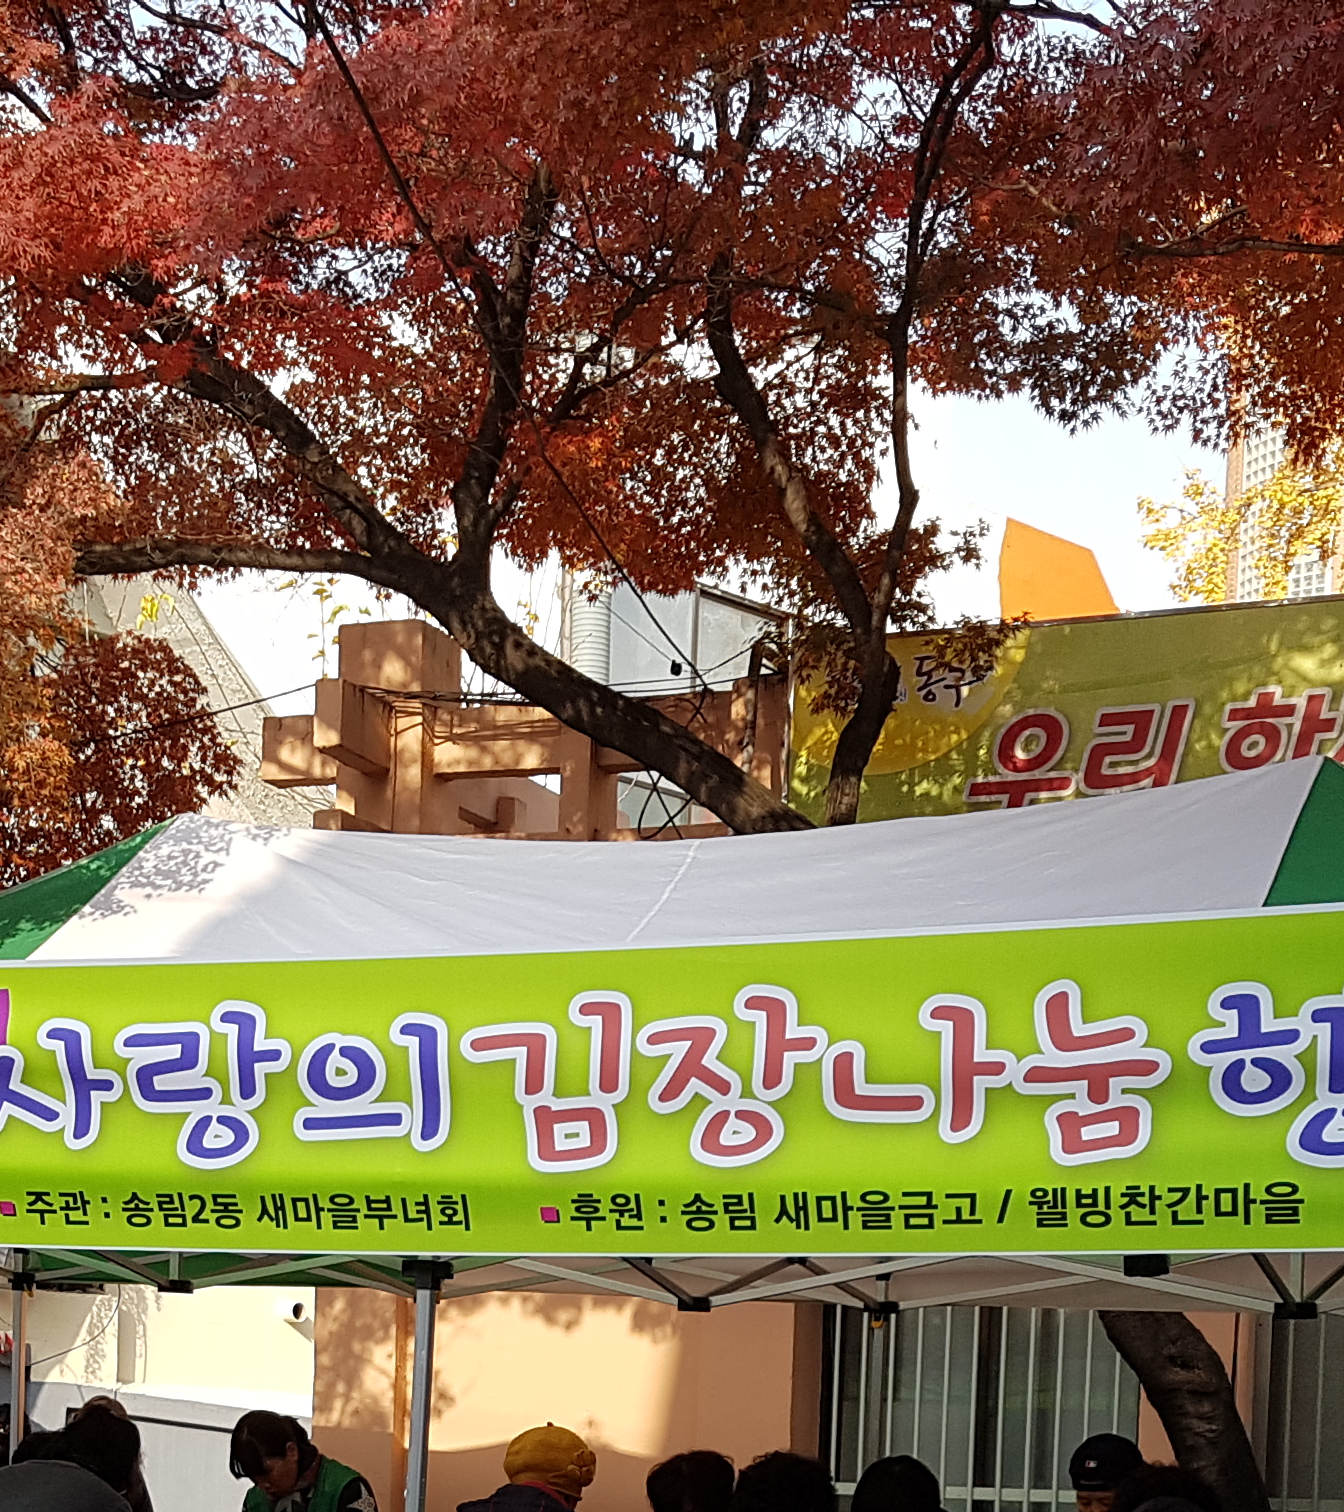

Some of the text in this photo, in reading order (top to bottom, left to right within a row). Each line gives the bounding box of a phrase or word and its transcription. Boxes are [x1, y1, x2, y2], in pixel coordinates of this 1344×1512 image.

[964, 698, 1195, 810] 우리
[121, 1191, 245, 1230] 송림2동
[256, 1193, 473, 1232] 새마을부녀회
[680, 1191, 757, 1232] 송림
[773, 1189, 983, 1232] 새마을금고
[1027, 1180, 1306, 1229] 웰빙찬간마을
